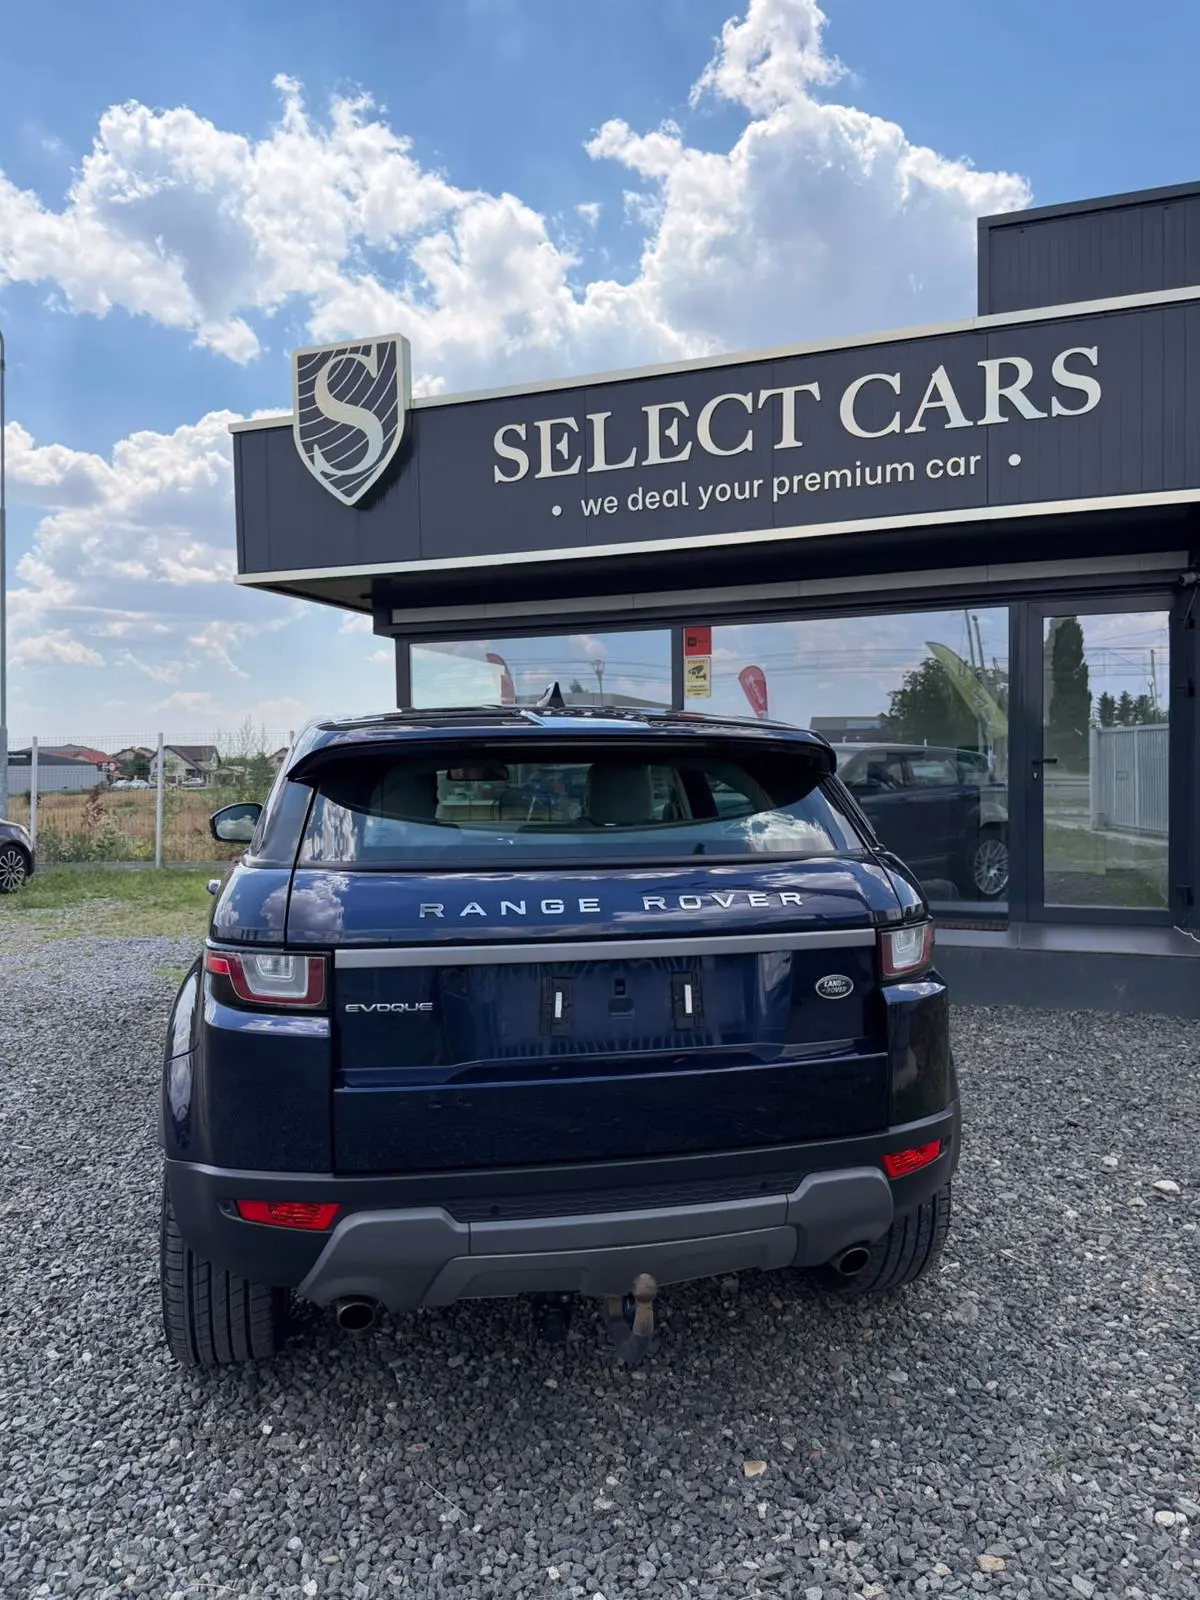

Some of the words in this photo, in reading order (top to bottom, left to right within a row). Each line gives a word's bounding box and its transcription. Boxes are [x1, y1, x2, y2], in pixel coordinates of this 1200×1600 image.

[492, 381, 822, 484] SELECT
[839, 345, 1103, 438] CARS
[580, 494, 619, 517] we
[627, 481, 690, 513] deal
[698, 476, 764, 511] your
[773, 460, 916, 503] premium
[925, 453, 982, 479] car
[419, 898, 601, 918] RANGE
[642, 891, 804, 911] ROVER
[345, 1002, 434, 1013] EVOQUE
